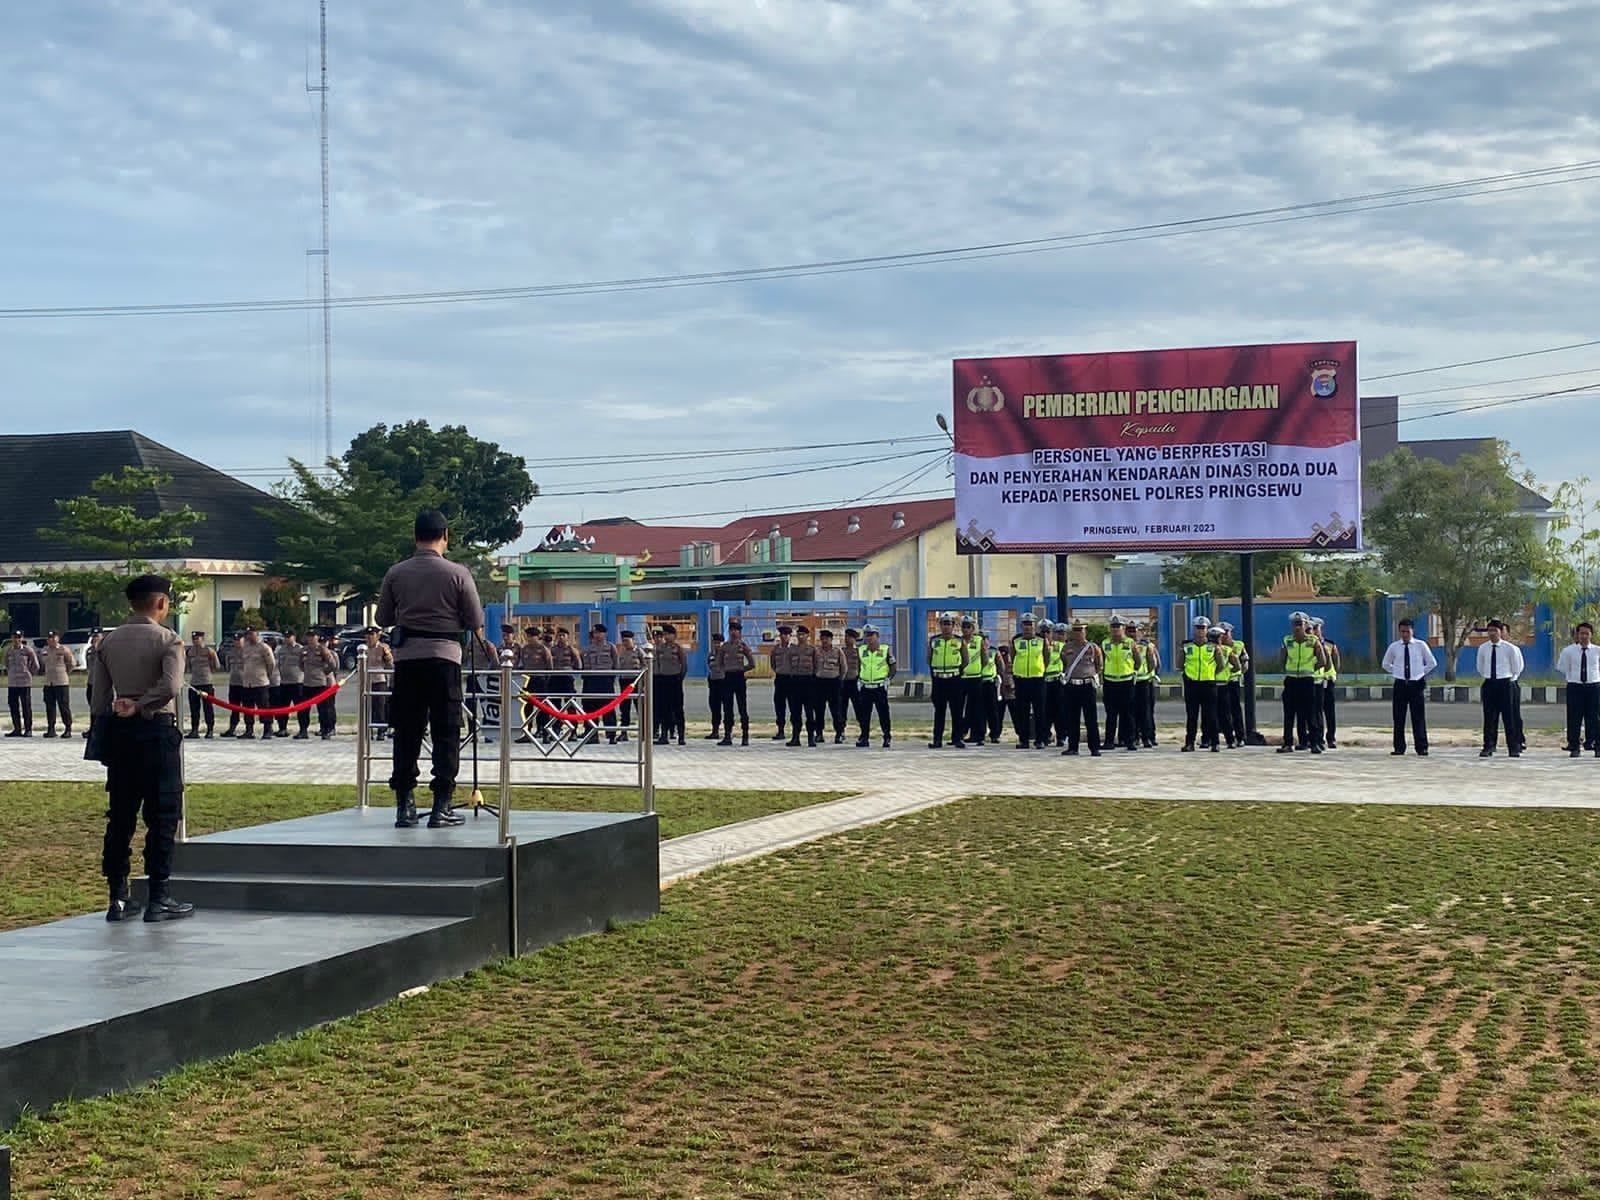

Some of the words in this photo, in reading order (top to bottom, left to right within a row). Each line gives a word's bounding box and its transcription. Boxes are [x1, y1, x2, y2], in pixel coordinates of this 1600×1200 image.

[1023, 391, 1131, 418] PEMBERIAN
[1135, 384, 1279, 414] PENGHARGAAN
[1034, 448, 1112, 464] PERSONEL
[1116, 446, 1157, 461] YANG
[1162, 443, 1266, 460] BERPRESTASI
[970, 471, 999, 485] DAN
[1003, 468, 1102, 485] PENYERAHAN
[1108, 465, 1200, 481] KENDARAAN
[1205, 463, 1253, 479] DINAS
[1257, 462, 1300, 478] RODA
[1305, 461, 1338, 476] DUA
[1001, 489, 1059, 504] KEPADA
[1063, 487, 1141, 502] PERSONEL
[1145, 486, 1204, 500] POLRES
[1209, 482, 1302, 499] PRINGSEWU
[1083, 526, 1140, 535] PRINGSEWU,
[1145, 524, 1191, 534] FEBRUARI
[1193, 524, 1216, 533] 2023
